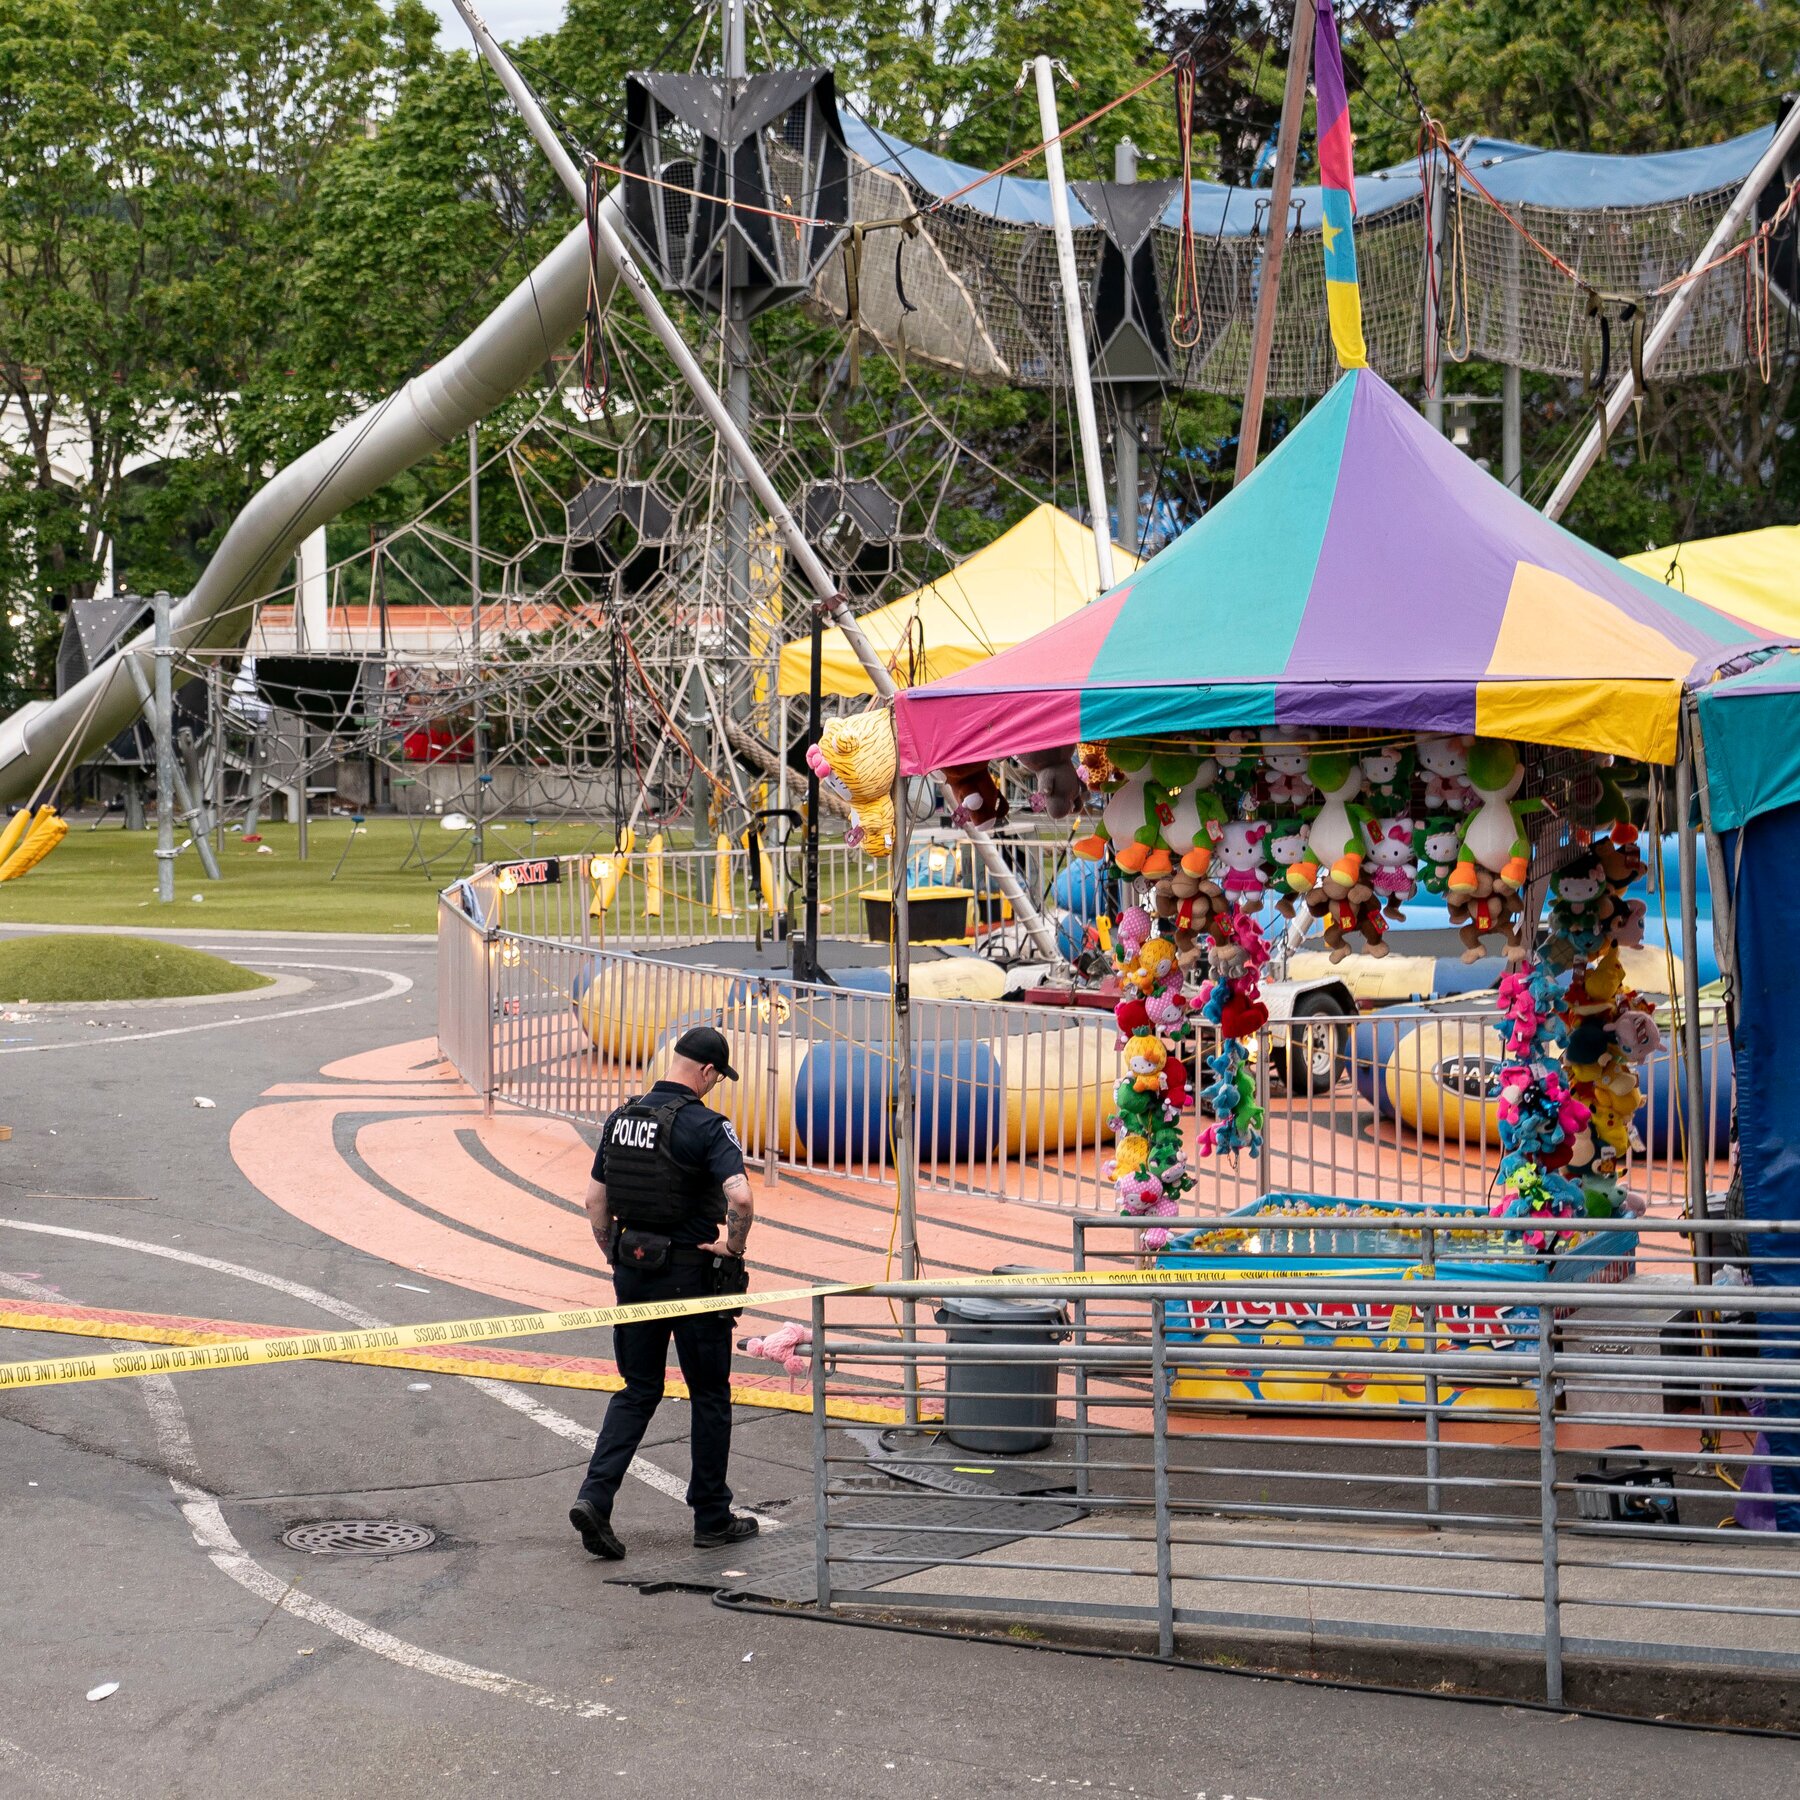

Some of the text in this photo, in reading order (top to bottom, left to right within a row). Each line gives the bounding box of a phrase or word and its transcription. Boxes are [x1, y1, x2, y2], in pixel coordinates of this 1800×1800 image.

[509, 862, 548, 884] EXIT
[611, 1118, 658, 1149] POLICE
[560, 1302, 687, 1328] POLICE LINE DO NOT CROSS
[414, 1316, 545, 1343] POLICE LINE DO NOT CROSS
[266, 1331, 399, 1359] POLICE LINE DO NOT CROSS
[35, 1364, 58, 1381] LINE
[60, 1360, 96, 1379] POLICE
[113, 1345, 249, 1374] POLICE LINE DO NOT CROSS
[18, 1367, 32, 1383] DO
